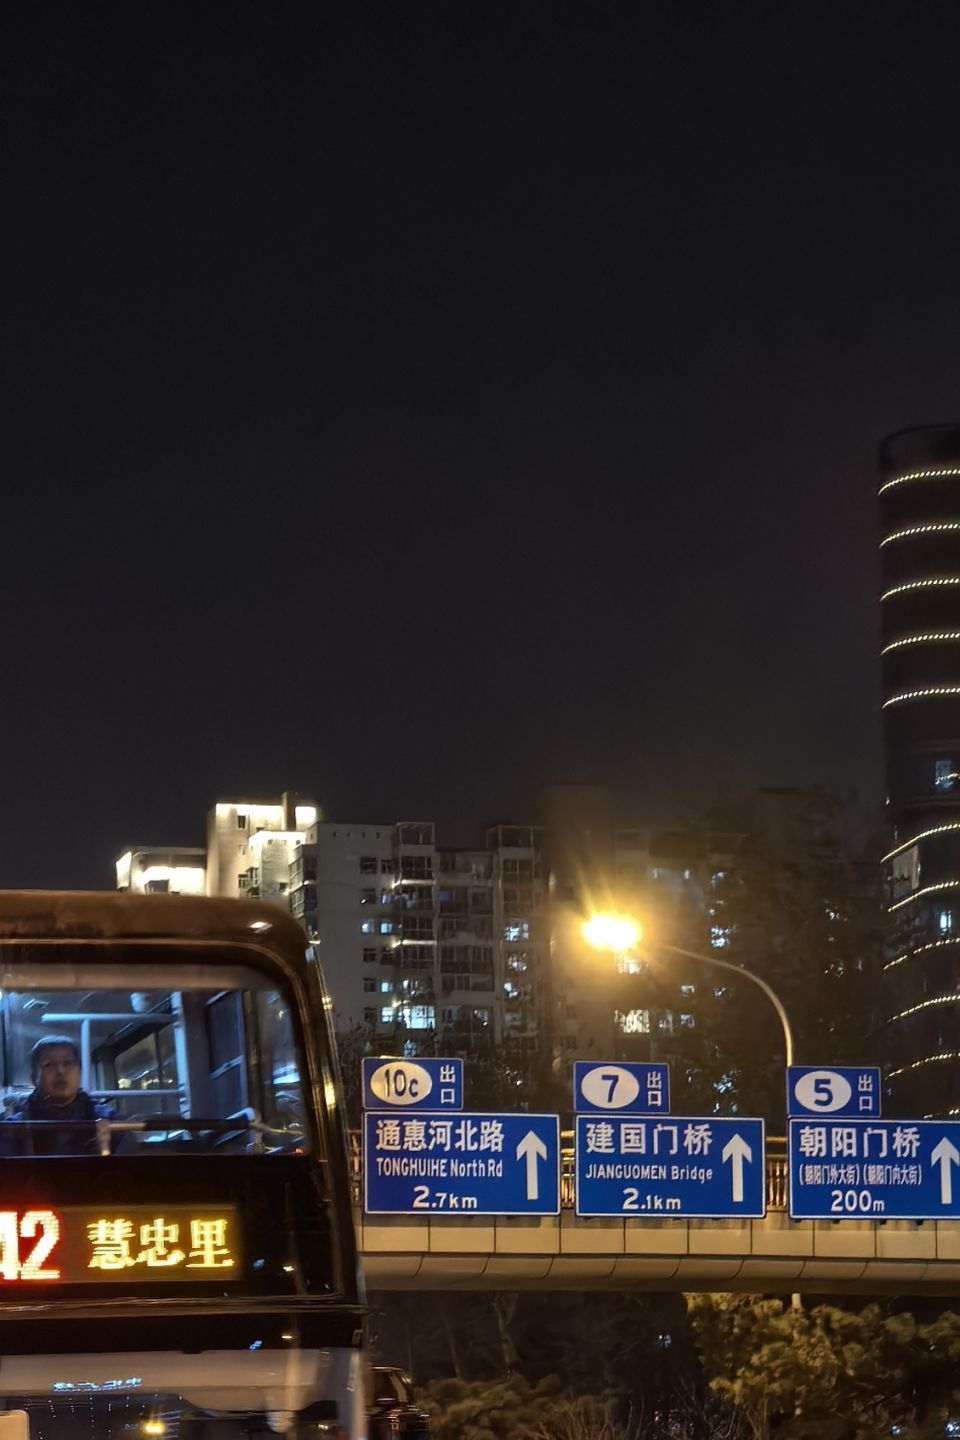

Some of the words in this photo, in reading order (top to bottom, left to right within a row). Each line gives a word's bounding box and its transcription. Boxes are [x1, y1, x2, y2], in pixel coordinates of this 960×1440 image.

[439, 1064, 456, 1105] 出口
[601, 1074, 620, 1103] 7
[646, 1070, 662, 1107] 出口
[813, 1078, 834, 1107] 5
[857, 1073, 873, 1111] 出口
[375, 1119, 505, 1152] 通惠河北路
[585, 1121, 713, 1156] 建国门桥
[798, 1125, 921, 1159] 朝阳门桥
[376, 1157, 447, 1178] TONGHUIHE
[450, 1158, 486, 1178] North
[488, 1158, 503, 1178] Rd
[585, 1163, 667, 1180] JIANGUOMEN
[671, 1165, 713, 1184] Bridge
[412, 1185, 478, 1209] 2.7km
[622, 1187, 681, 1210] 2.1km
[830, 1189, 885, 1212] 200m
[86, 1218, 235, 1270] 慧忠里
